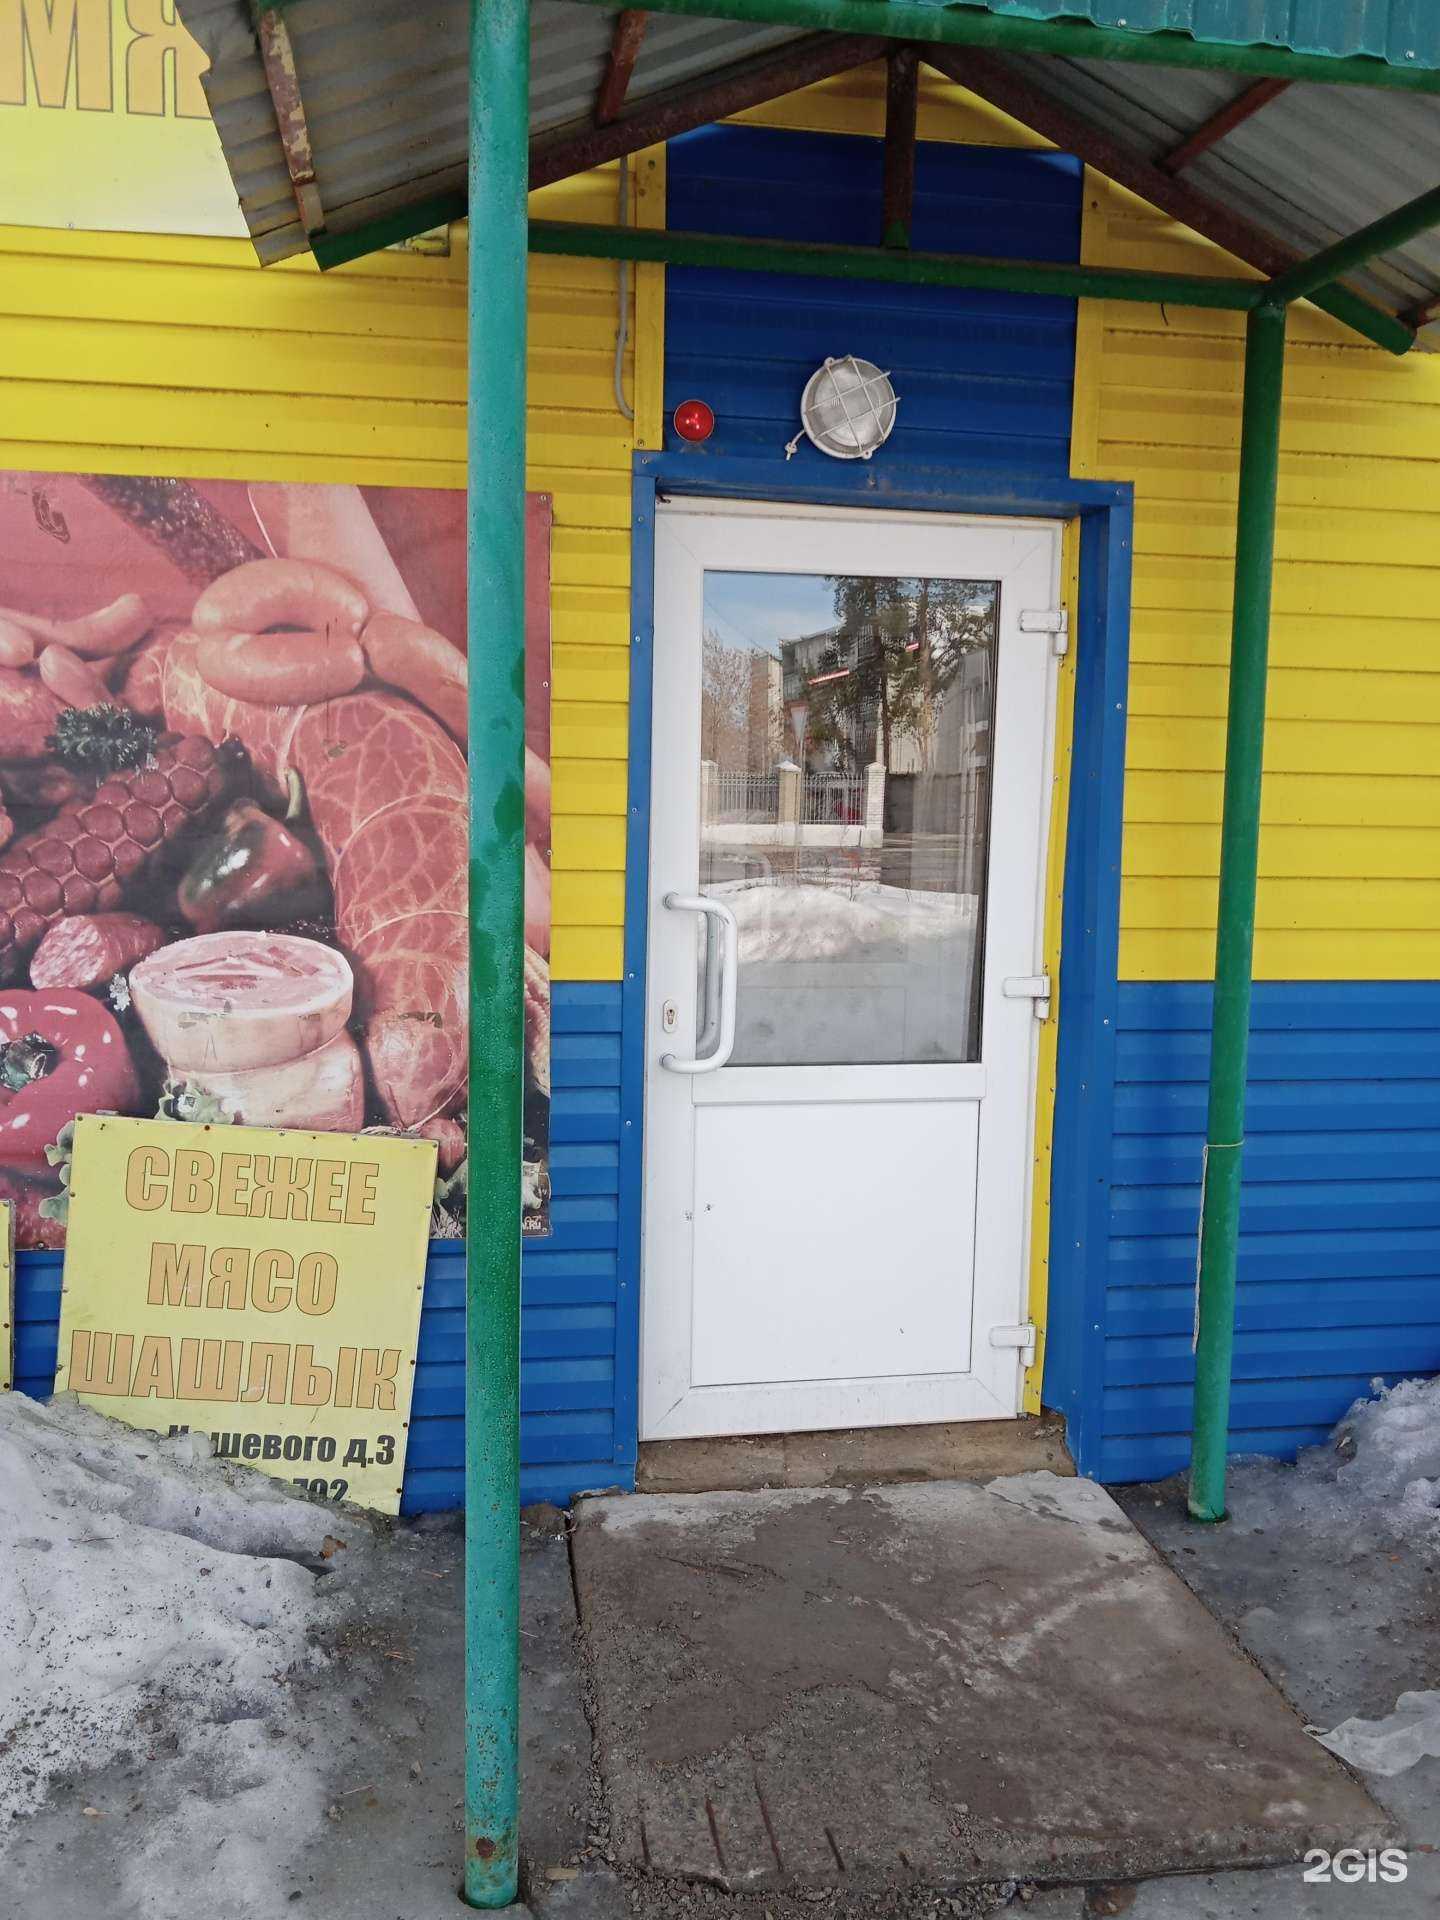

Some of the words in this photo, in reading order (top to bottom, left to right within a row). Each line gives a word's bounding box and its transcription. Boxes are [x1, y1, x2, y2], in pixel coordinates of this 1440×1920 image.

[125, 1145, 379, 1225] СВЕЖЕЕ
[146, 1241, 338, 1316] МЯСО
[68, 1329, 402, 1411] ШАШЛЫК
[168, 1424, 337, 1463] шевого
[341, 1434, 396, 1468] д.3
